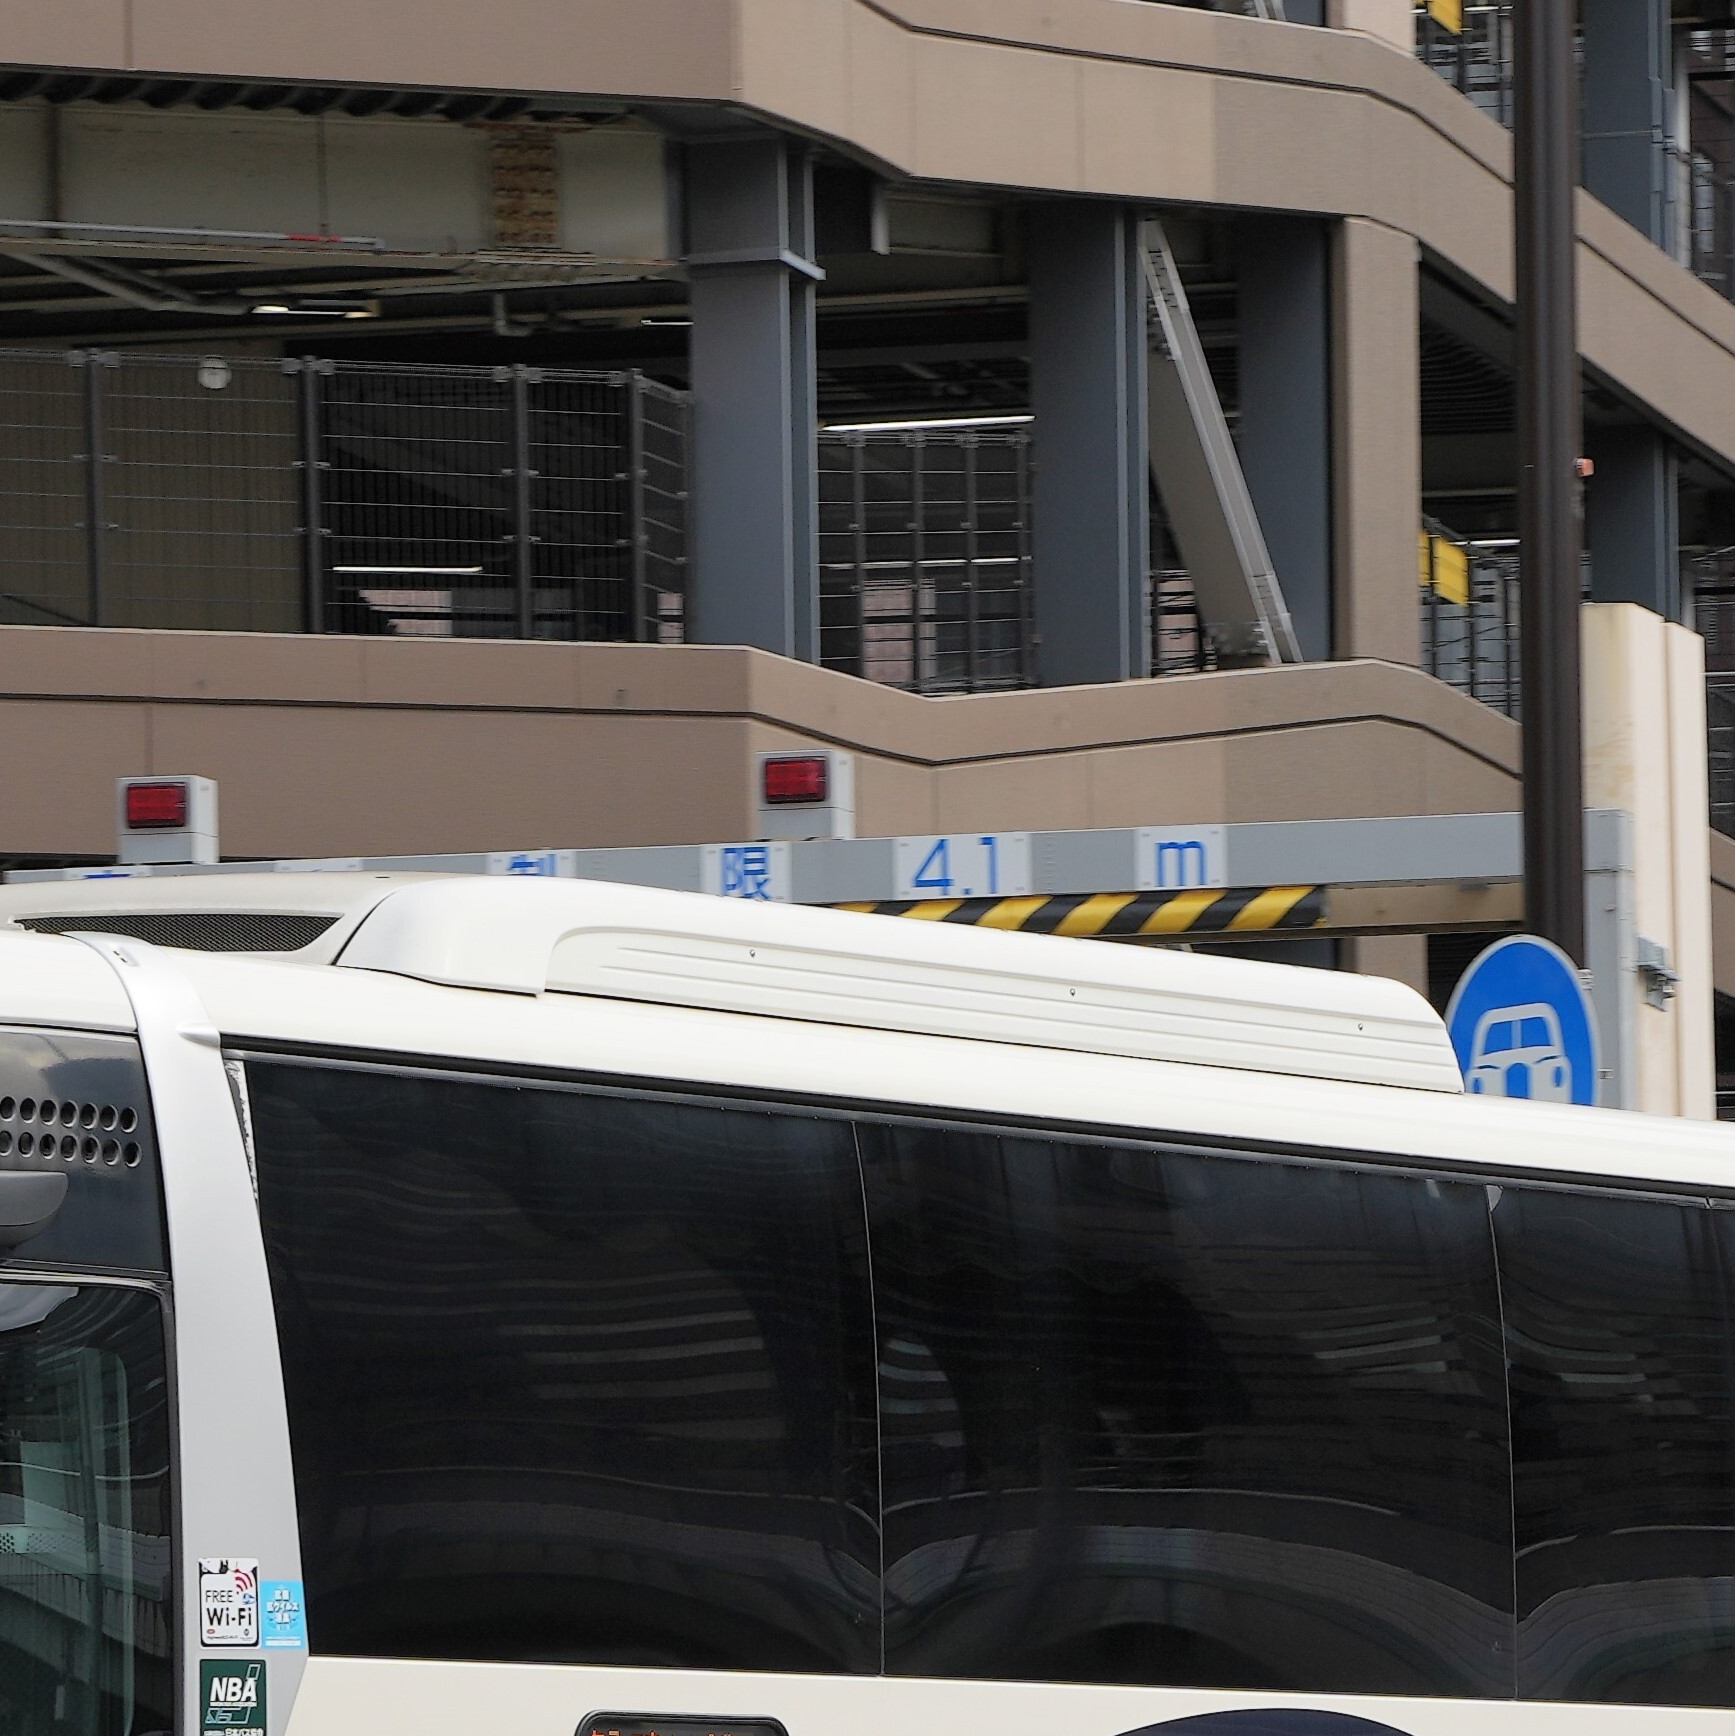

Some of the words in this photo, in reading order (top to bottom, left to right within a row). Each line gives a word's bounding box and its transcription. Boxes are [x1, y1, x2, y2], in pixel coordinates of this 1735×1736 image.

[912, 836, 998, 896] 4.1
[1154, 839, 1207, 888] m
[205, 1589, 234, 1603] FREE
[206, 1607, 252, 1626] Wi-Fi
[209, 1676, 258, 1702] NBA
